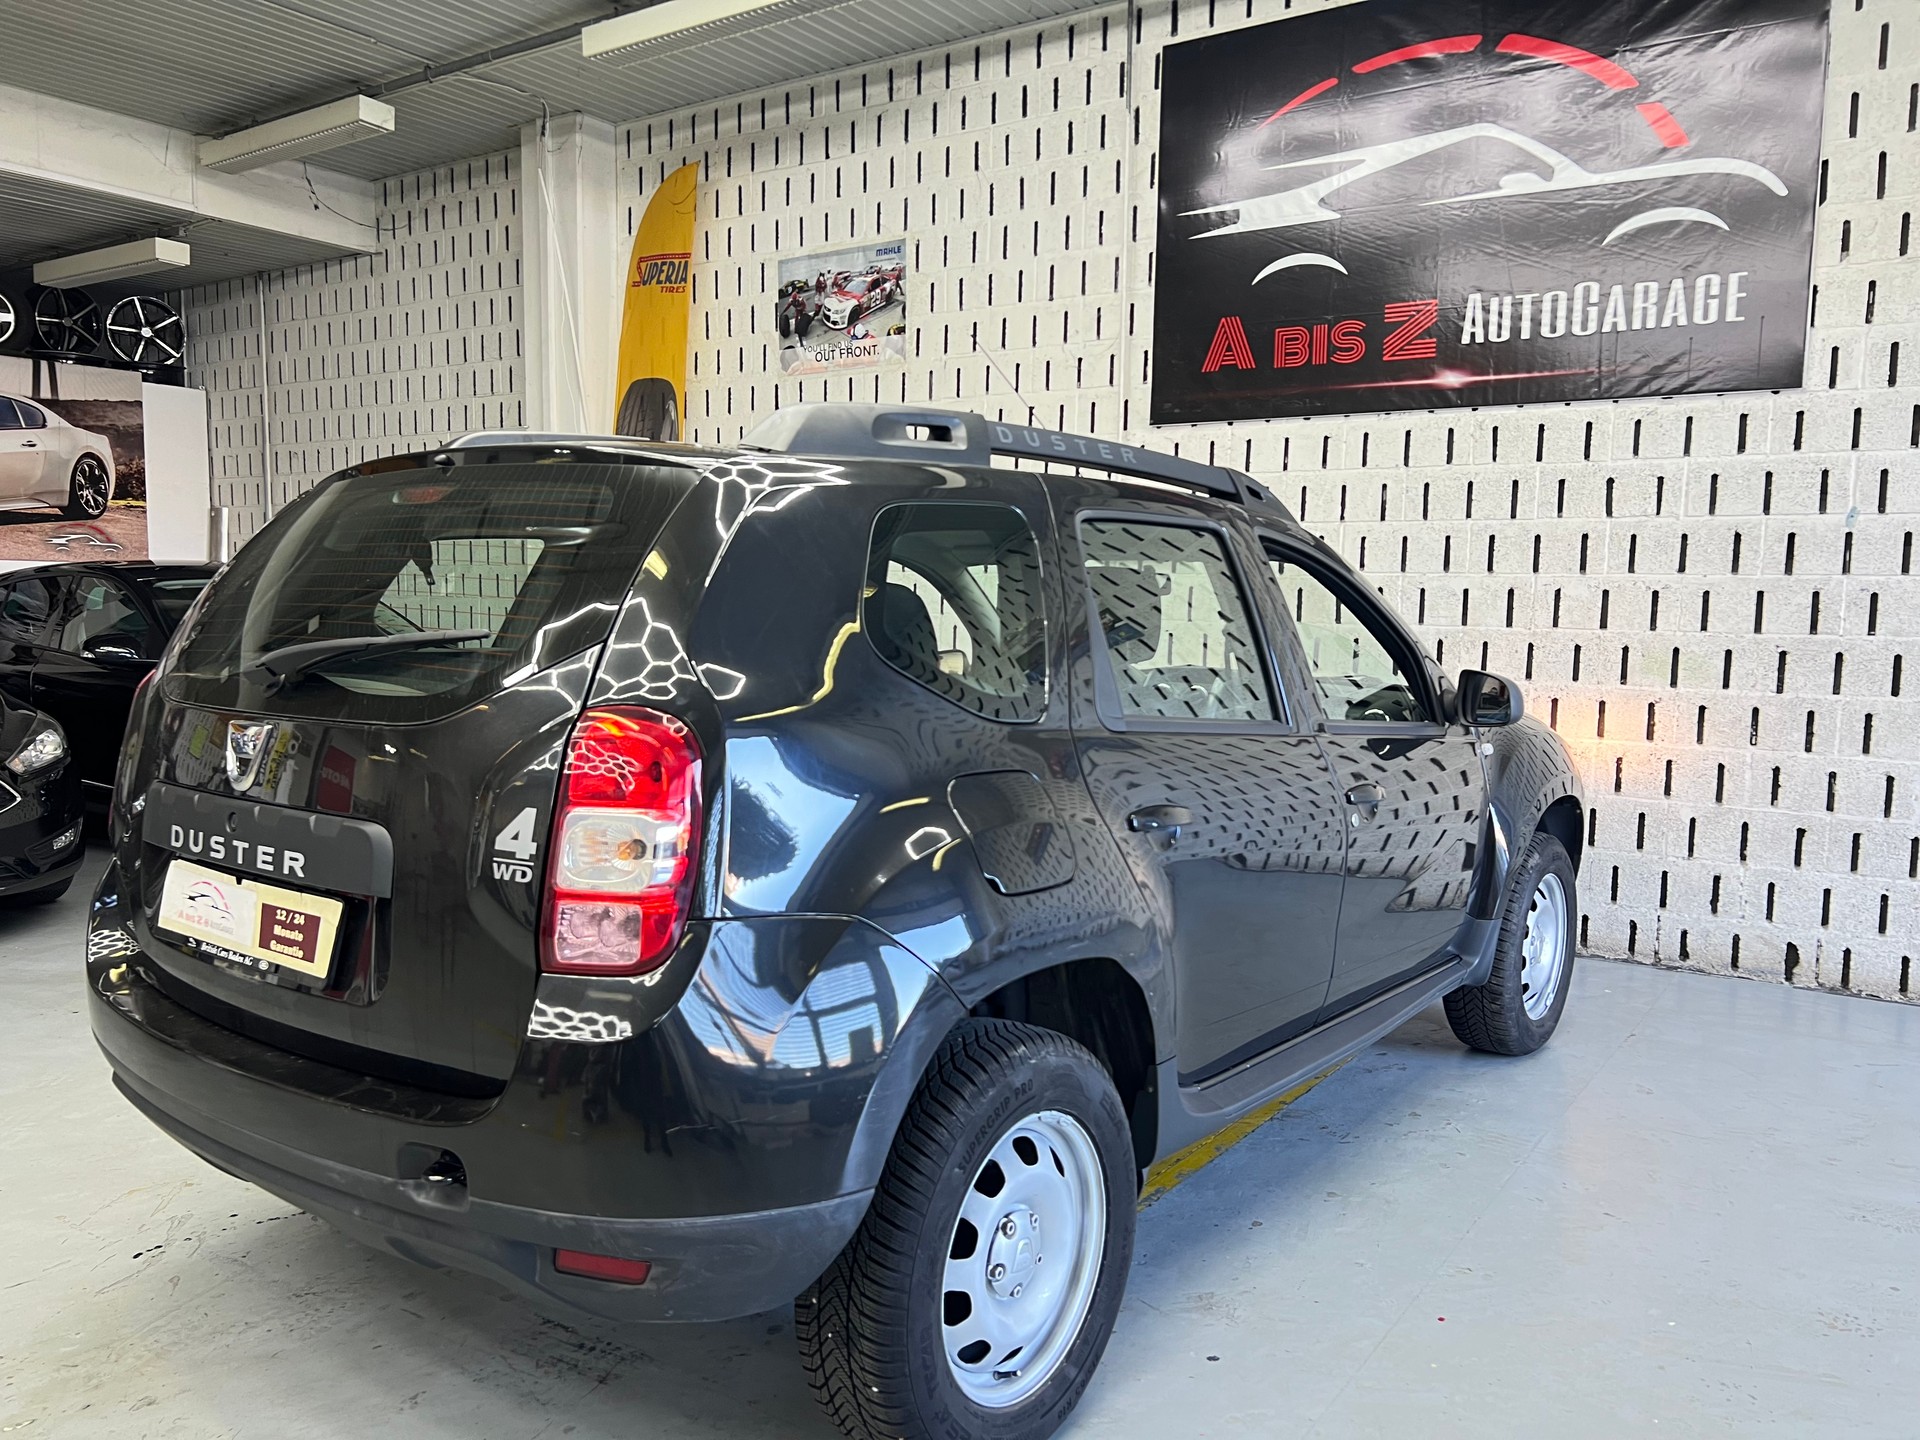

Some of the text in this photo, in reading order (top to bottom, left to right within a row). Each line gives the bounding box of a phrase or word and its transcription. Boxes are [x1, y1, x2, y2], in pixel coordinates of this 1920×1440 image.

[876, 245, 902, 257] MAHLE
[632, 253, 692, 287] SUPERIA
[660, 285, 687, 294] TIRES
[870, 289, 882, 307] 29
[829, 341, 842, 350] FIND
[844, 340, 854, 348] US
[1201, 315, 1257, 373] A
[1274, 319, 1366, 368] BIS
[1382, 298, 1438, 361] Z
[815, 344, 880, 363] OUT FRONT.
[995, 425, 1138, 464] DUSTER
[493, 807, 538, 860] 4
[170, 824, 307, 879] DUSTER
[492, 861, 535, 884] WD
[273, 924, 304, 942] Monate
[270, 940, 304, 958] Garantie
[958, 1078, 1034, 1174] SUPERGRIP PRO
